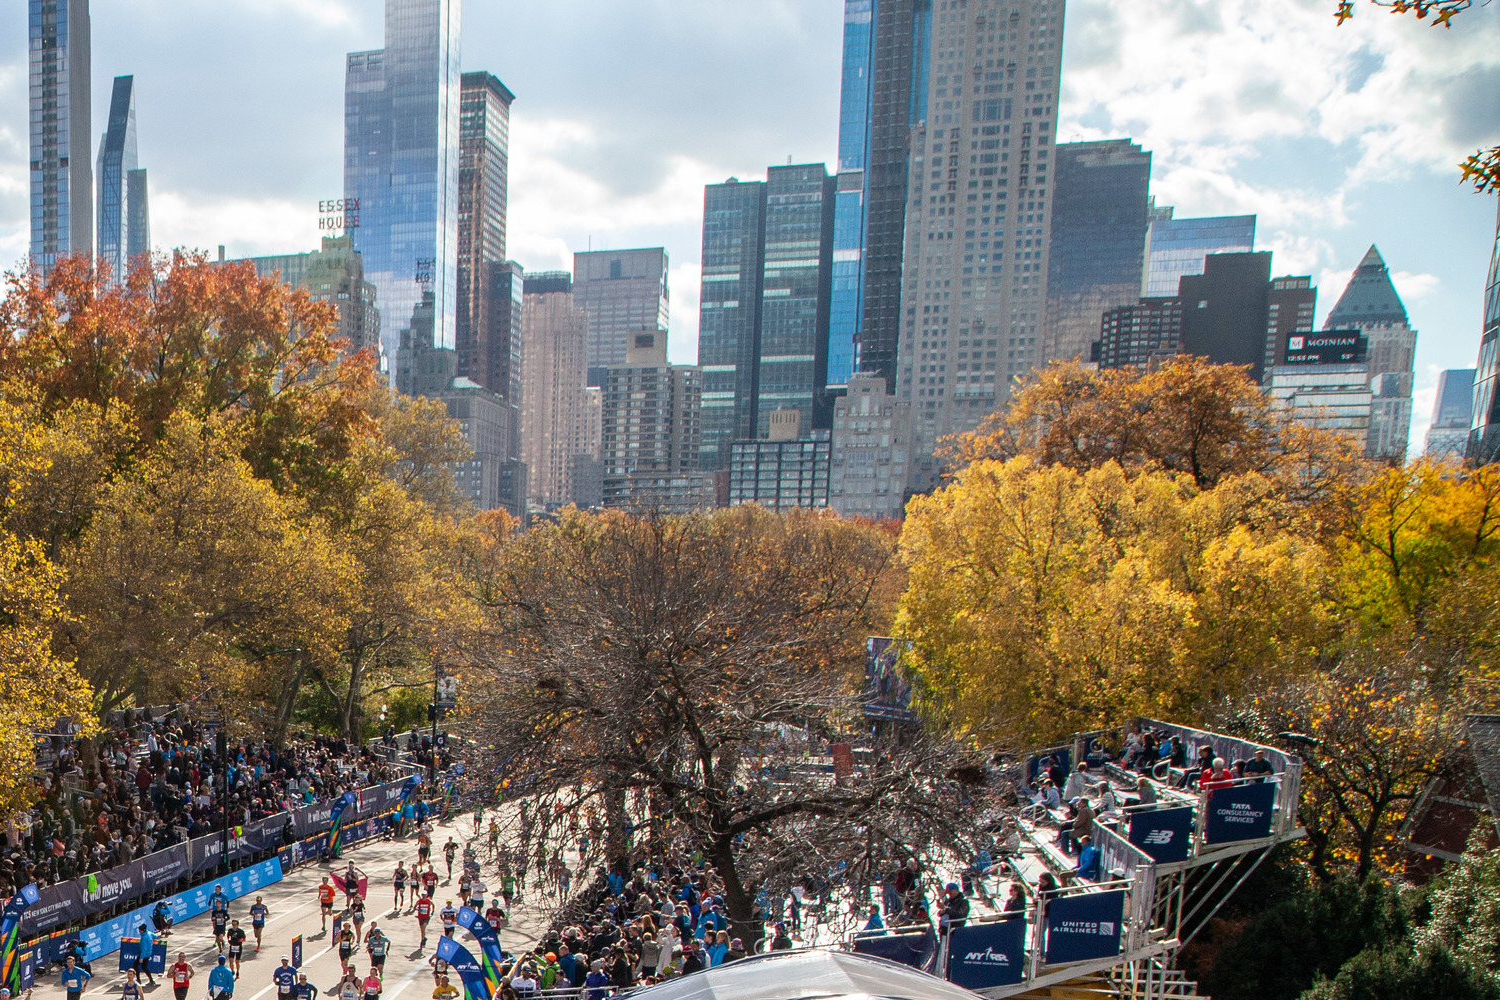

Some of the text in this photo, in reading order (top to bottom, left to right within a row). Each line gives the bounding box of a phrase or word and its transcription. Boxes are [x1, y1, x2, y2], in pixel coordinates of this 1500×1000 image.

[319, 198, 360, 212] ESSEX
[319, 215, 360, 229] HOUSE
[1307, 337, 1356, 347] MOINIAN
[1217, 809, 1264, 818] CONSULTANCY
[1225, 816, 1255, 824] SERVICES
[102, 882, 119, 898] move
[119, 878, 133, 894] you.
[23, 910, 31, 920] TCS
[31, 908, 40, 917] NEW
[40, 905, 49, 915] YORK
[1062, 921, 1098, 929] UNITED
[1053, 926, 1098, 935] AIRLINES
[965, 951, 1009, 962] NYRR
